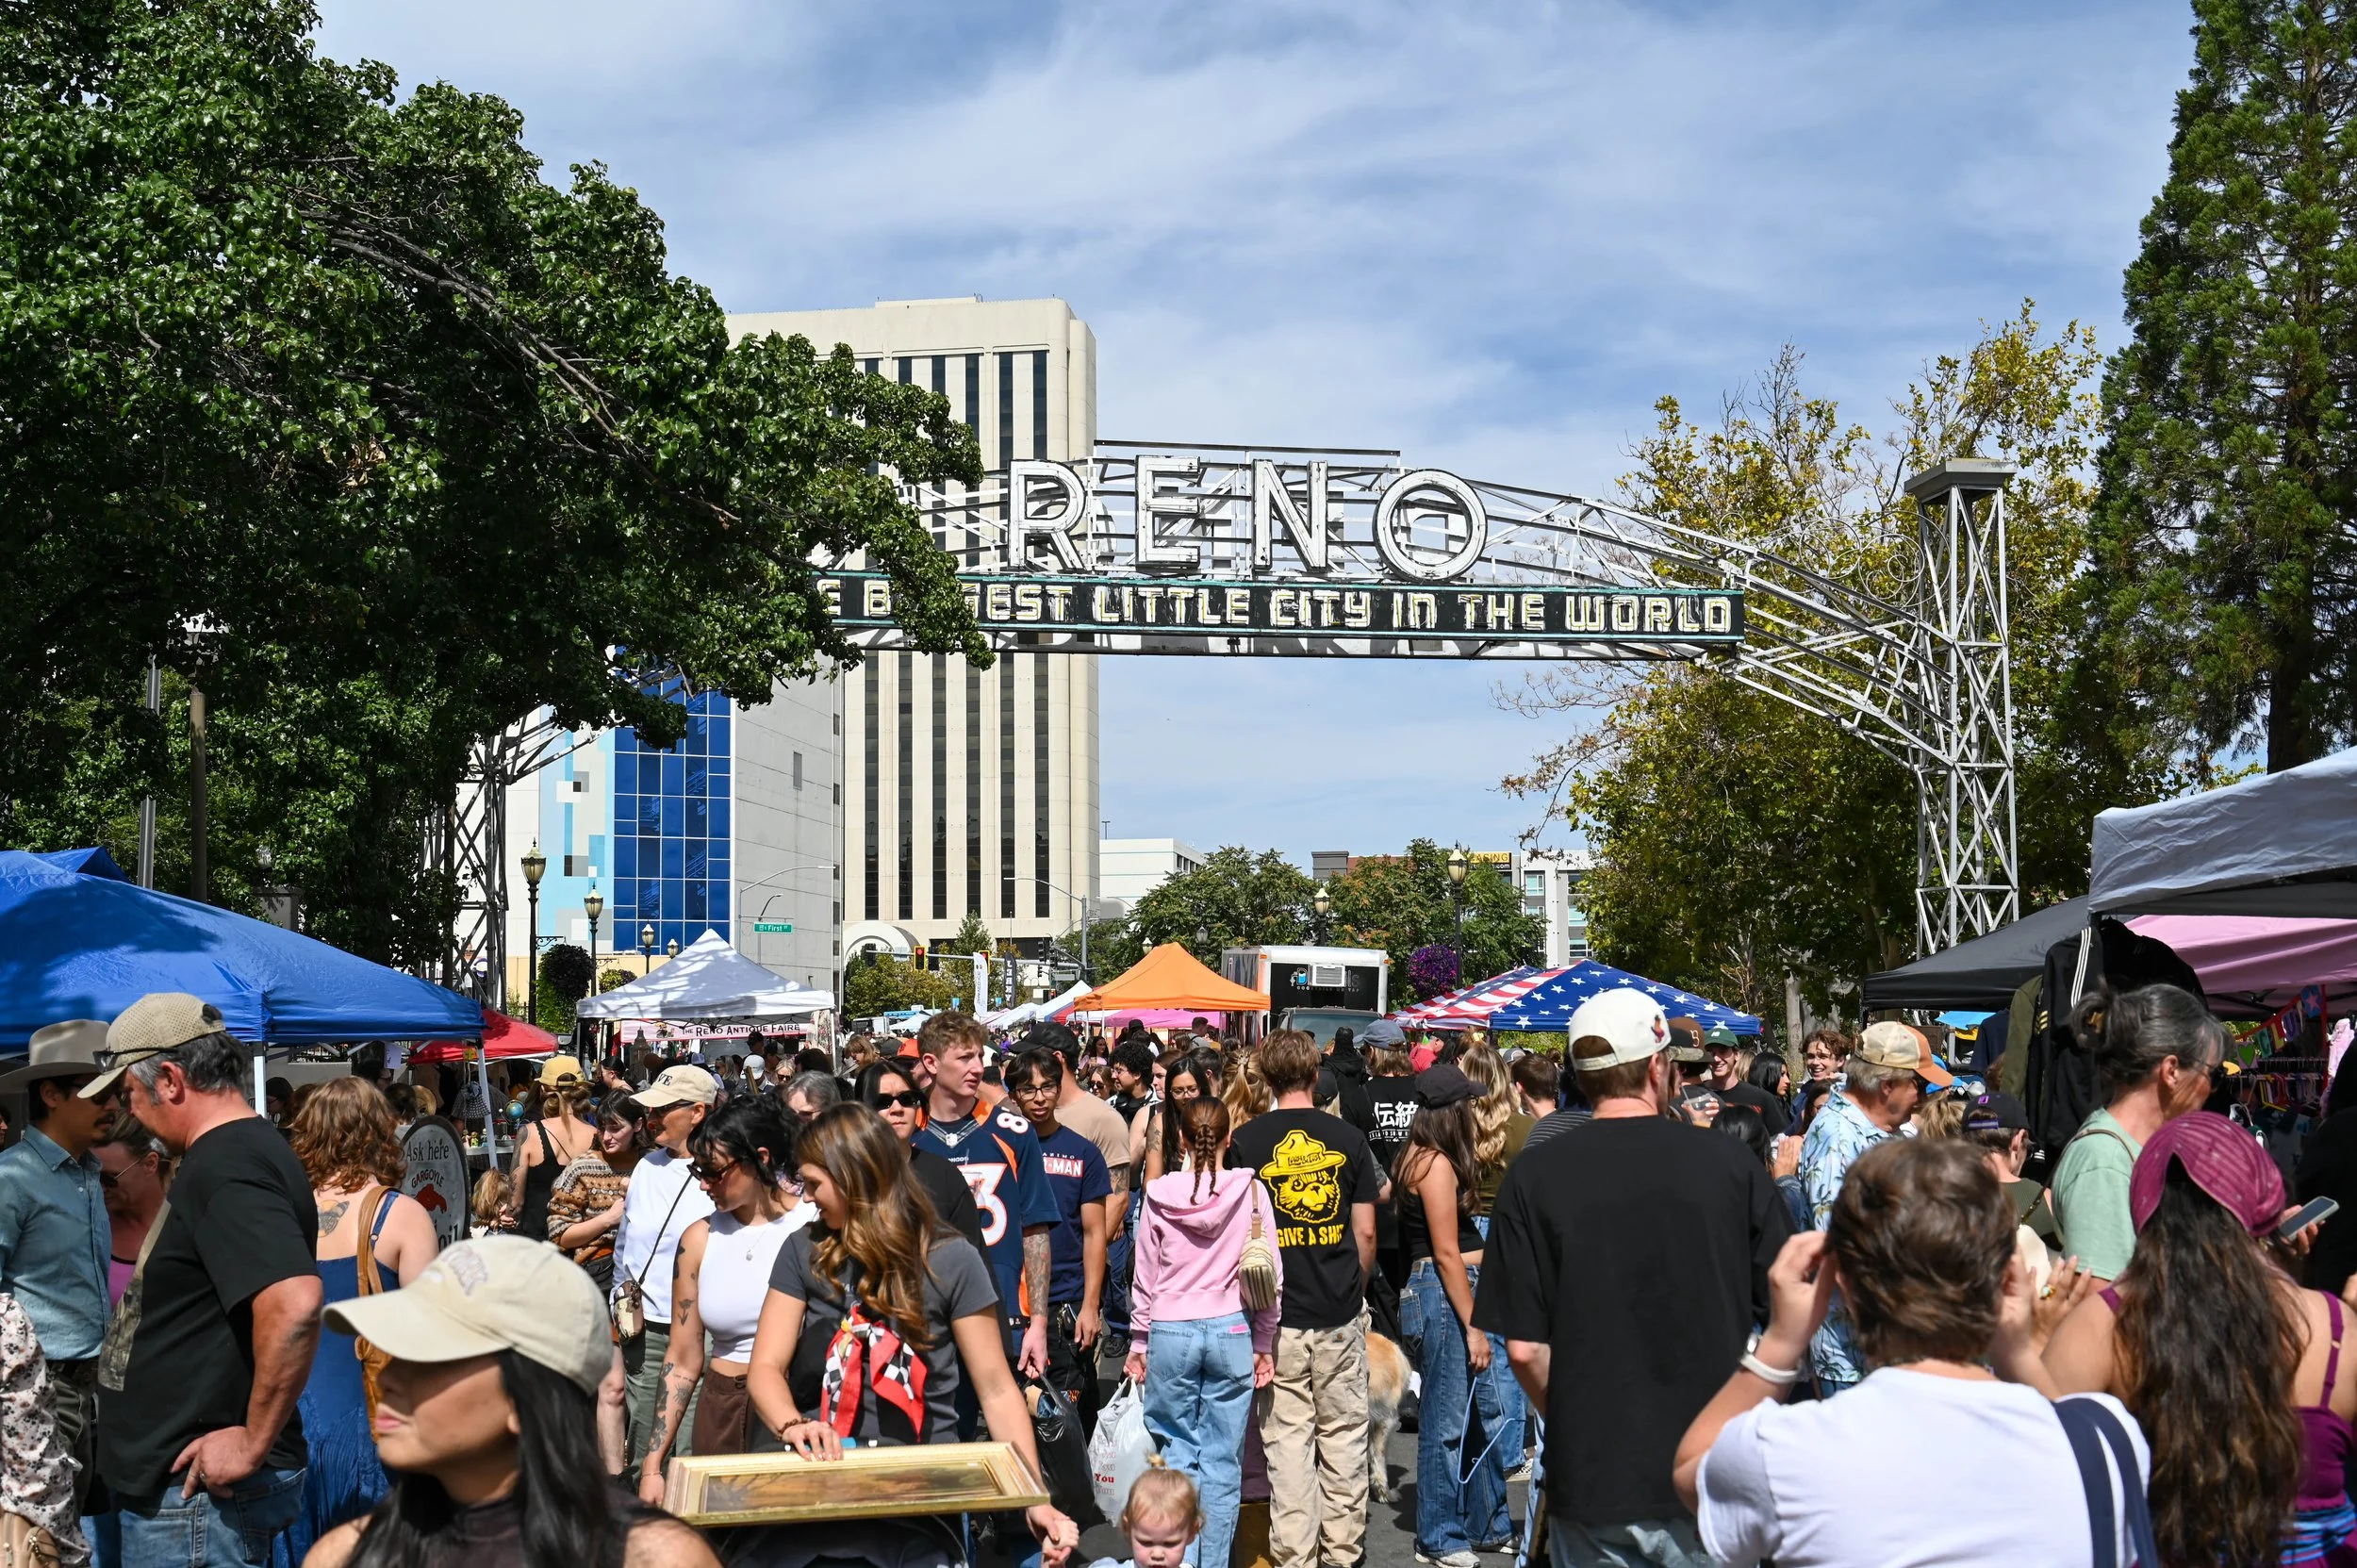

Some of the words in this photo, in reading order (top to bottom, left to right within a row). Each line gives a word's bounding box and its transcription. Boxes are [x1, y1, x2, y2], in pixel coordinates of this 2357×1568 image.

[1007, 454, 1488, 583] RENO
[1093, 585, 1250, 626] LITTLE
[1270, 589, 1371, 628] CITY
[1393, 592, 1438, 631] IN
[1458, 592, 1546, 632] THE
[1565, 594, 1732, 634] WORLD
[696, 1027, 723, 1036] RENO
[727, 1025, 769, 1035] ANTIQUE
[771, 1024, 800, 1033] FAIRE
[406, 1140, 424, 1162] Ask
[427, 1138, 450, 1161] here
[411, 1168, 445, 1189] GARGOYLE
[1277, 1227, 1305, 1246] GIVE
[1309, 1227, 1317, 1246] A
[1094, 1473, 1114, 1483] You
